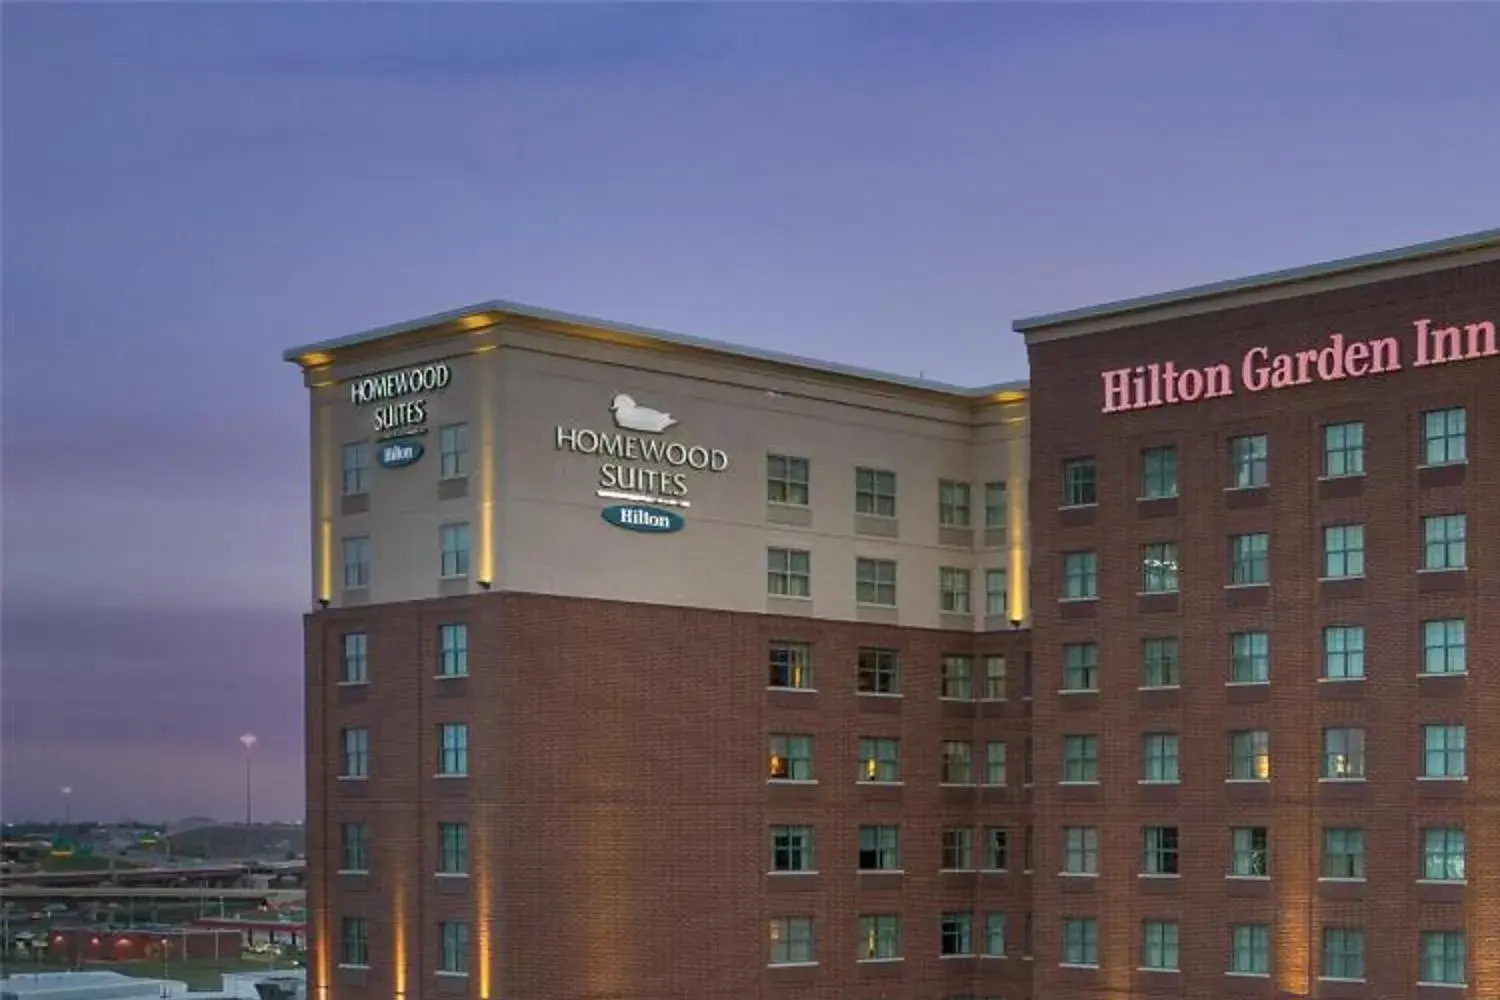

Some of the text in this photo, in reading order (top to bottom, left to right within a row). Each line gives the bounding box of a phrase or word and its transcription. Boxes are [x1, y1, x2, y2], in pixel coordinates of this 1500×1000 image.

[351, 364, 451, 403] HOMEWOOD
[1101, 319, 1499, 413] Hilton Garden Inn
[374, 400, 424, 431] SUITES
[557, 424, 728, 471] HOMEWOOD
[600, 463, 687, 496] SUITES
[620, 508, 670, 528] Hilton
